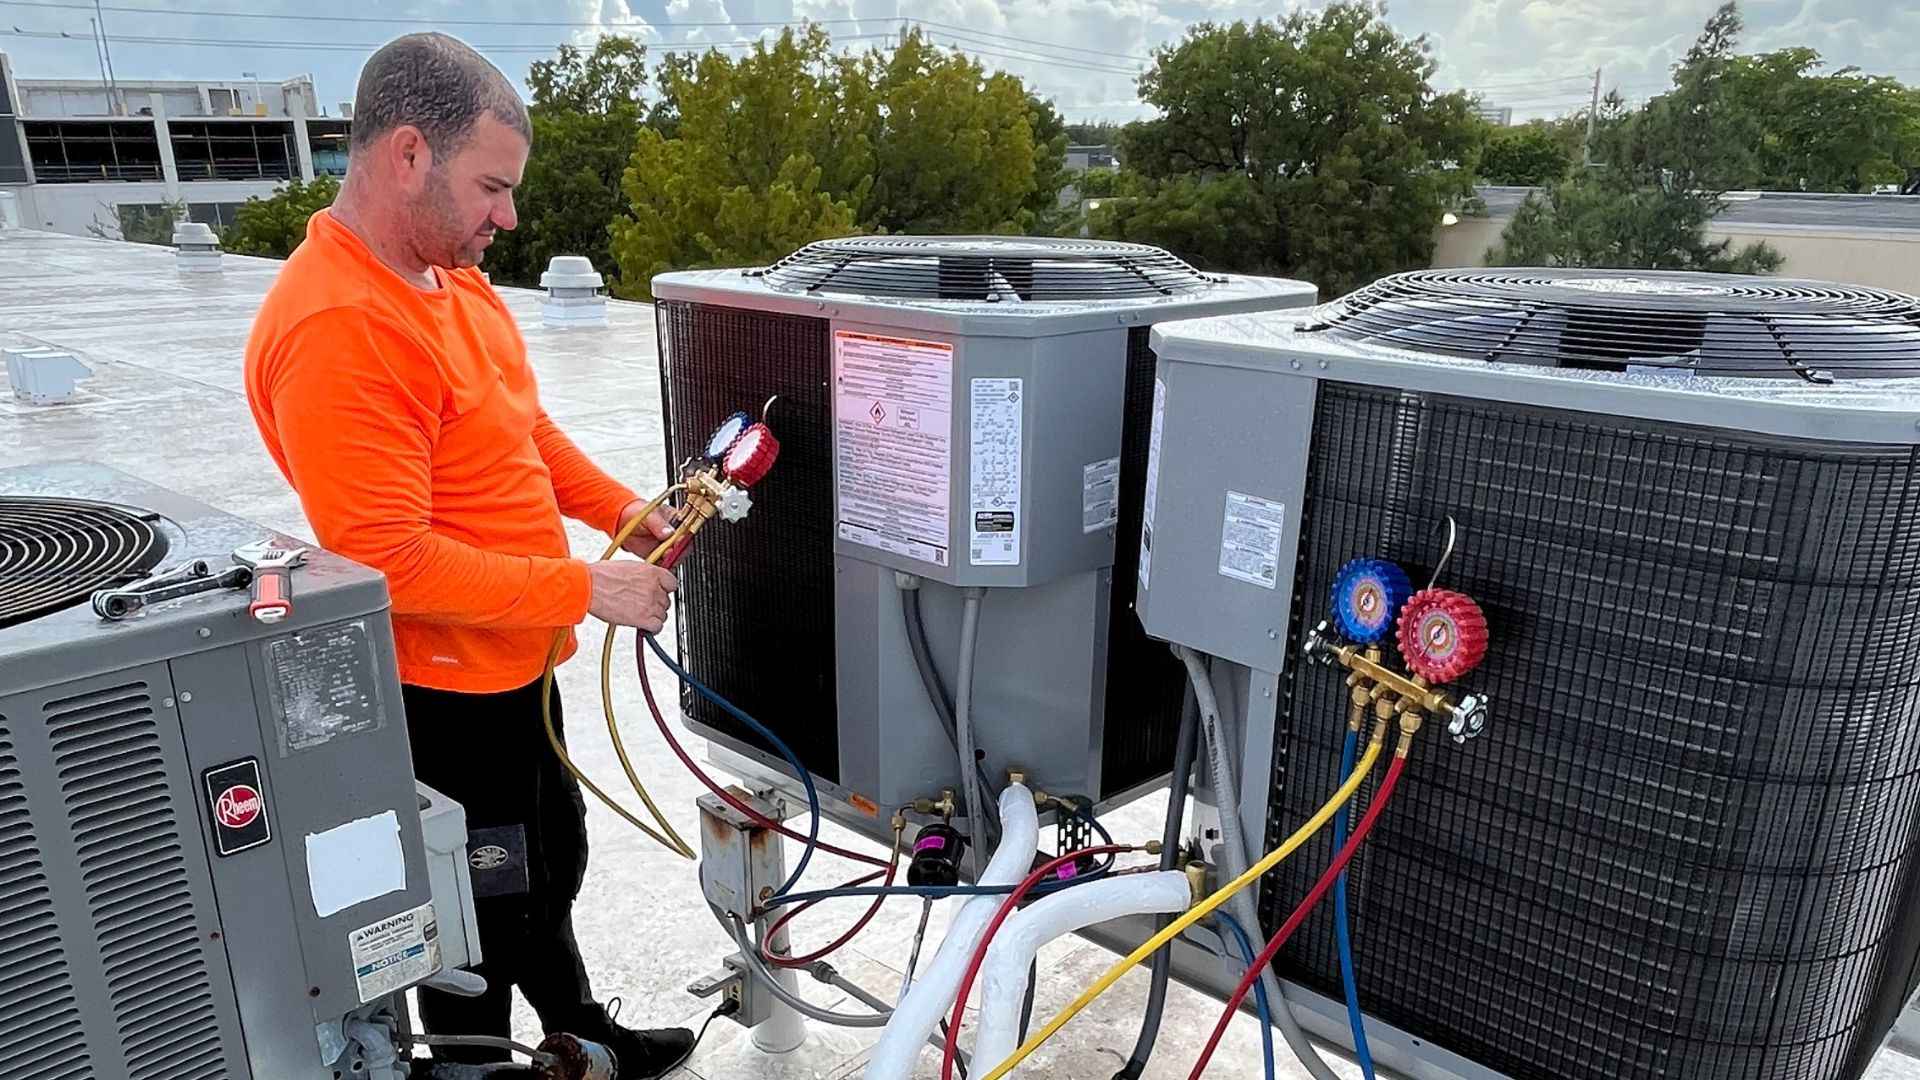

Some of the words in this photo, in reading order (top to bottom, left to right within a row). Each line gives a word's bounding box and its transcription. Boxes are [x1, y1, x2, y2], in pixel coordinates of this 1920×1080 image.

[220, 789, 258, 823] Rheem
[363, 913, 415, 938] WARNING
[371, 949, 409, 971] NOTICE
